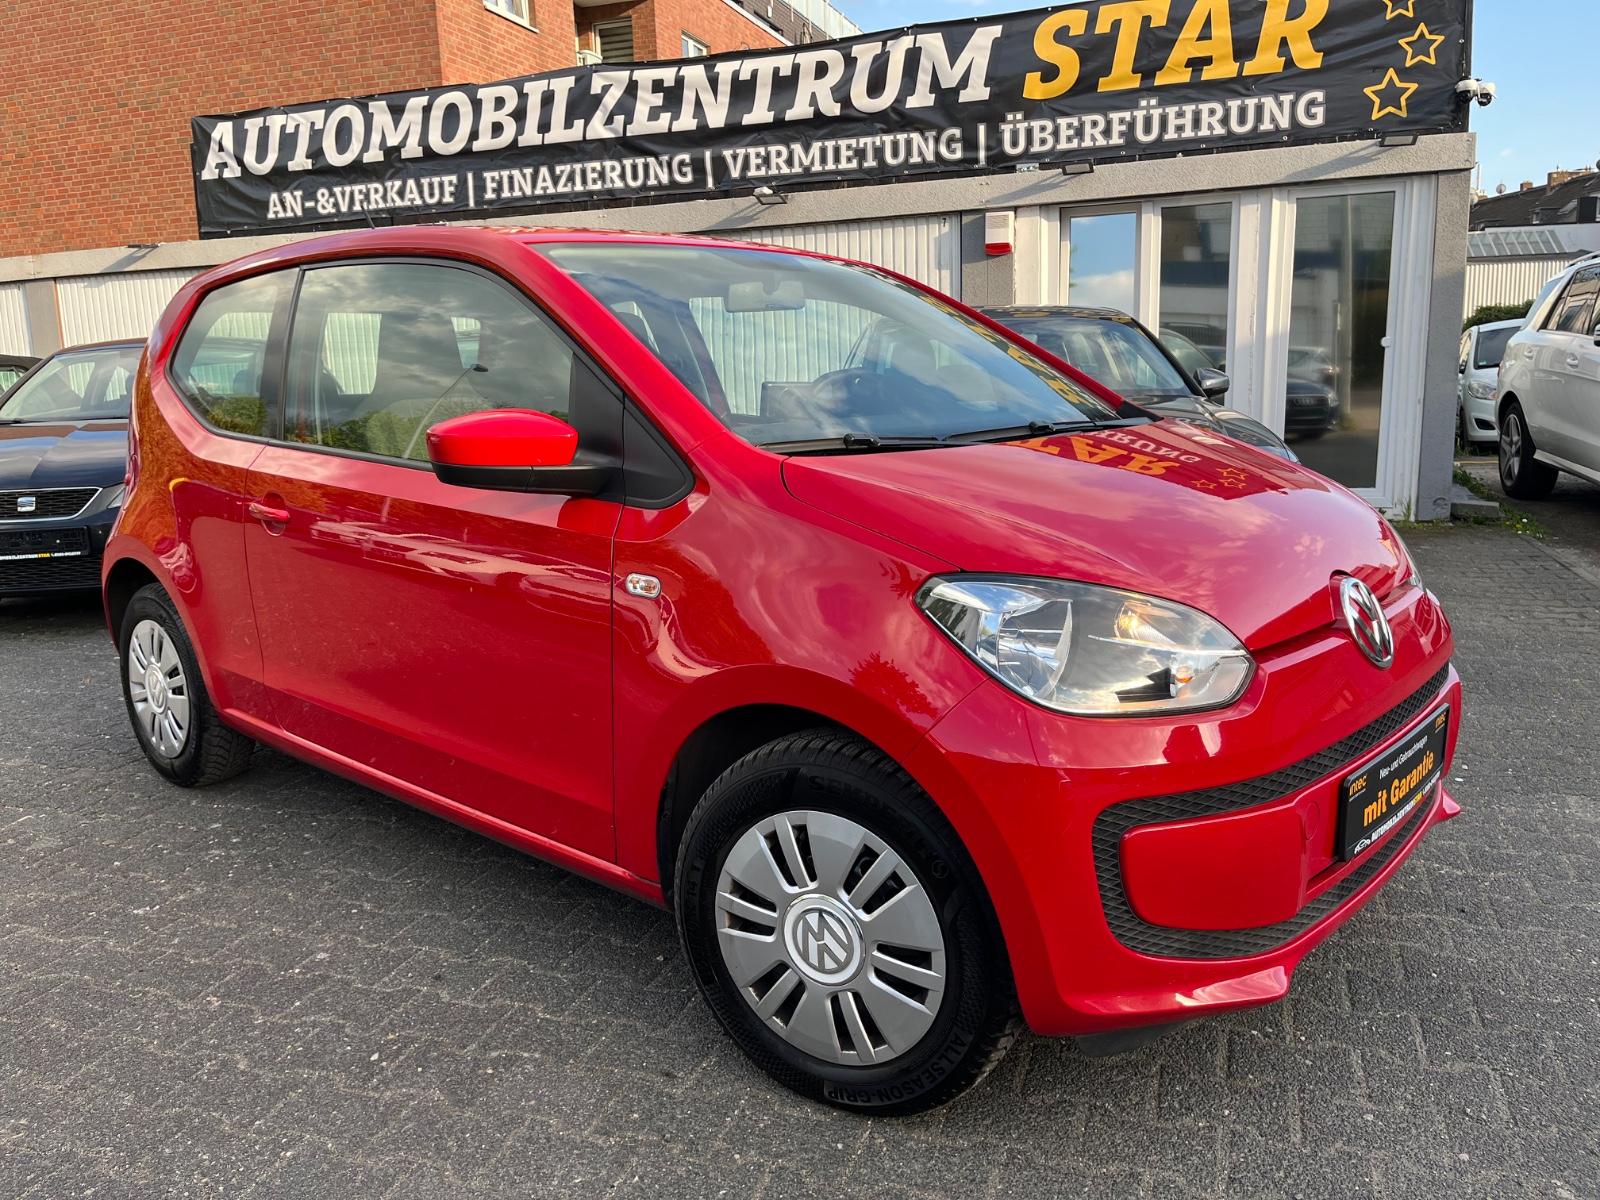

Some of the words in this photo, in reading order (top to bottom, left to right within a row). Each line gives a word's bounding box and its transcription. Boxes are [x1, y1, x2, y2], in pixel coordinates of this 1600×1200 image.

[201, 25, 1003, 180] AUTOMOBILZENTRUM
[1022, 0, 1330, 100] STAR
[267, 174, 458, 219] AN-&VERKAUF
[483, 153, 694, 200] FINAZIERUNG
[722, 126, 964, 180] VERMIETUNG
[999, 89, 1327, 156] ÜBERFÜHRUNG
[1363, 789, 1388, 828] mit
[1390, 750, 1434, 805] Garantie
